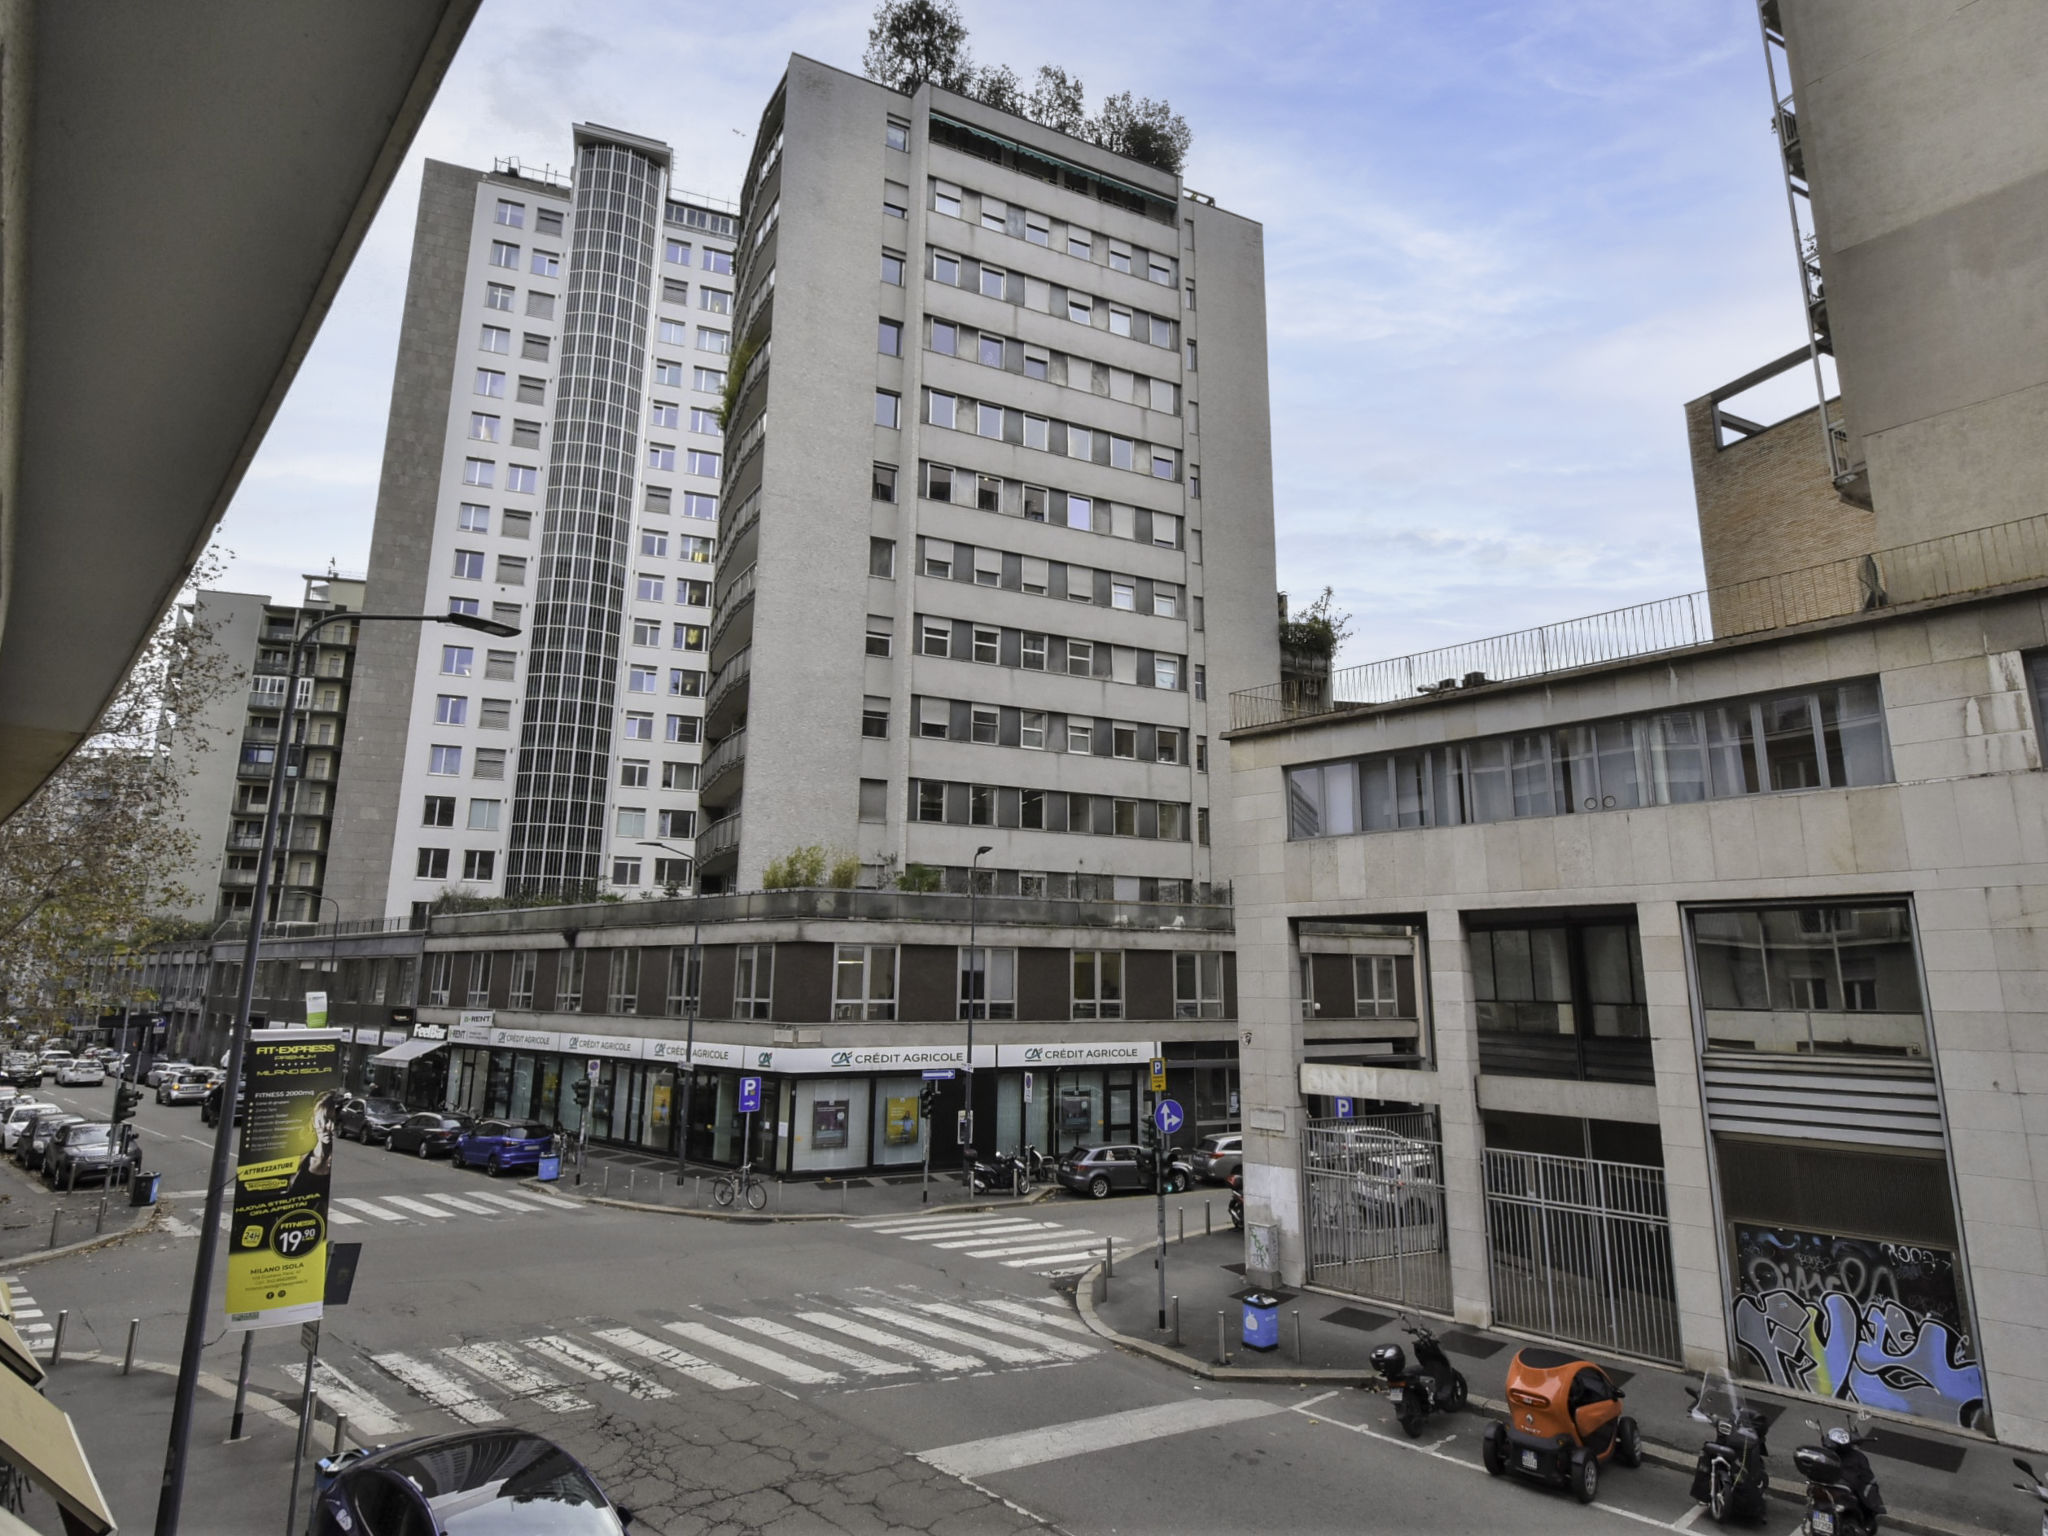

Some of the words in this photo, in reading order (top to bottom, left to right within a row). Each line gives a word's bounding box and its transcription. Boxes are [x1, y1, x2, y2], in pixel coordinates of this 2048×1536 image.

[579, 1040, 600, 1049] CRÉDIT
[600, 1042, 631, 1052] AGRICOLE
[666, 1045, 687, 1056] CRÉD
[692, 1049, 728, 1060] AGRICOLE
[855, 1053, 900, 1064] CRÉDIT
[902, 1052, 964, 1063] AGRICOLE
[1044, 1048, 1084, 1059] CRÉDIT
[1086, 1048, 1138, 1058] AGRICOLE
[256, 1069, 299, 1077] MILANO
[299, 1066, 333, 1075] ISOLA
[1154, 1062, 1161, 1074] P
[744, 1079, 757, 1097] P
[1337, 1098, 1350, 1118] P
[243, 1162, 293, 1175] ATTREZZATURE
[235, 1203, 267, 1213] NUOVA
[267, 1193, 321, 1208] STRUTTURA
[249, 1208, 269, 1217] ORA
[280, 1219, 317, 1229] FITNESS
[250, 1265, 281, 1275] MILANO
[281, 1262, 305, 1271] ISOLA
